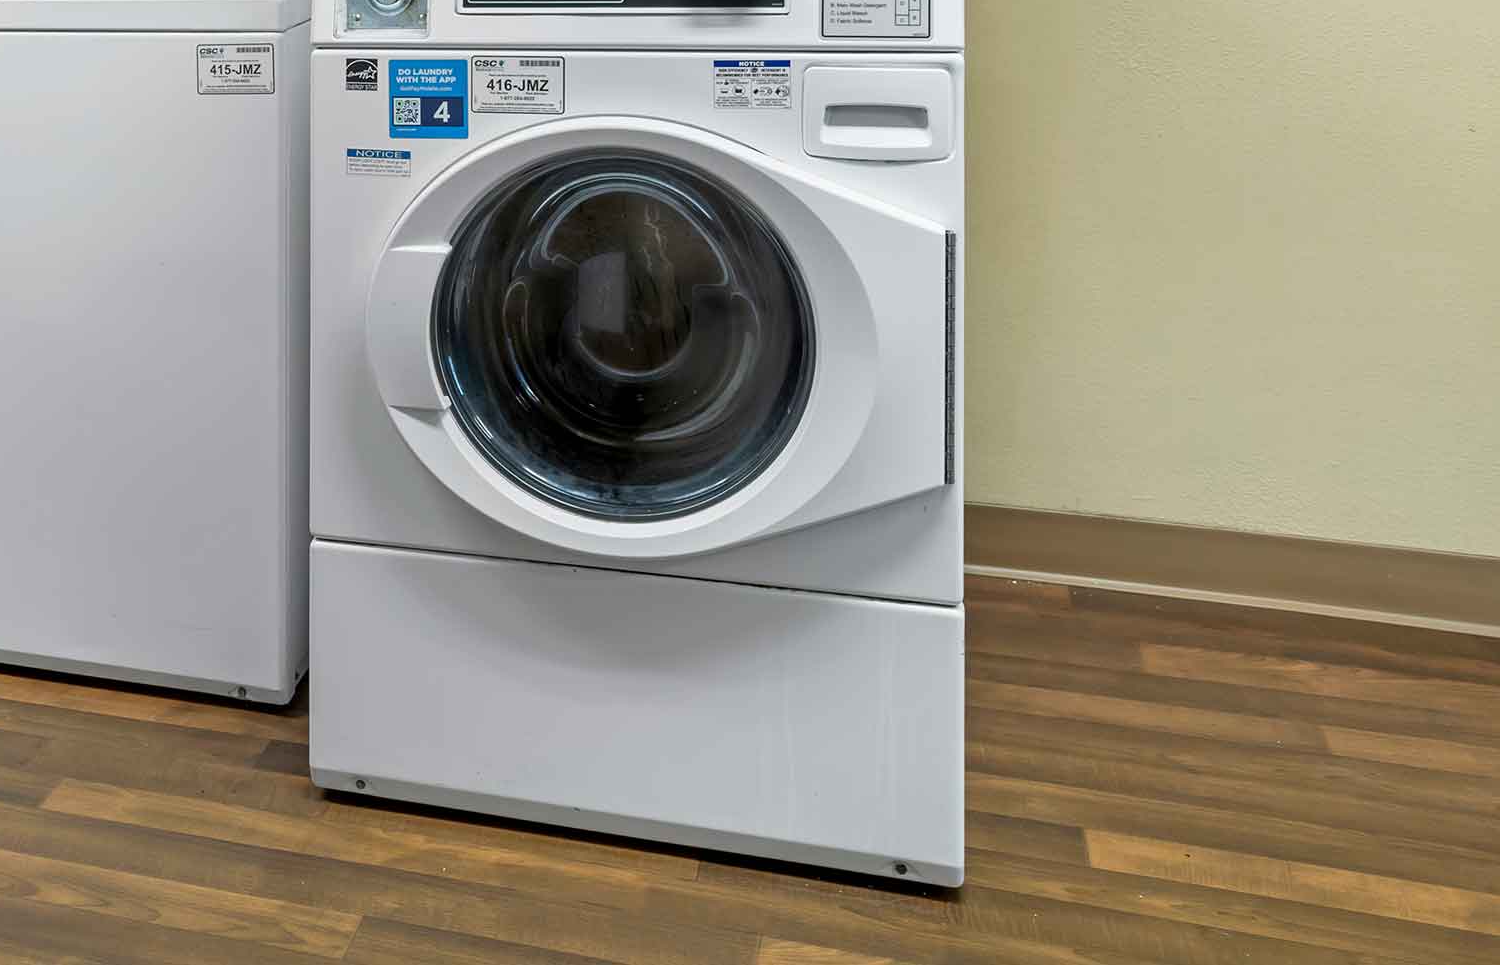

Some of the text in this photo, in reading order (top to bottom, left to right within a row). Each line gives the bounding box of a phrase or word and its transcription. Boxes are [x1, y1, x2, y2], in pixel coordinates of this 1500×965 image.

[474, 59, 497, 67] CSC
[210, 64, 262, 75] 415-JMZ
[398, 68, 453, 76] DO LAUNDRY
[486, 78, 549, 92] 416-JMZ
[433, 101, 451, 123] 4
[356, 150, 401, 158] NOTICE
